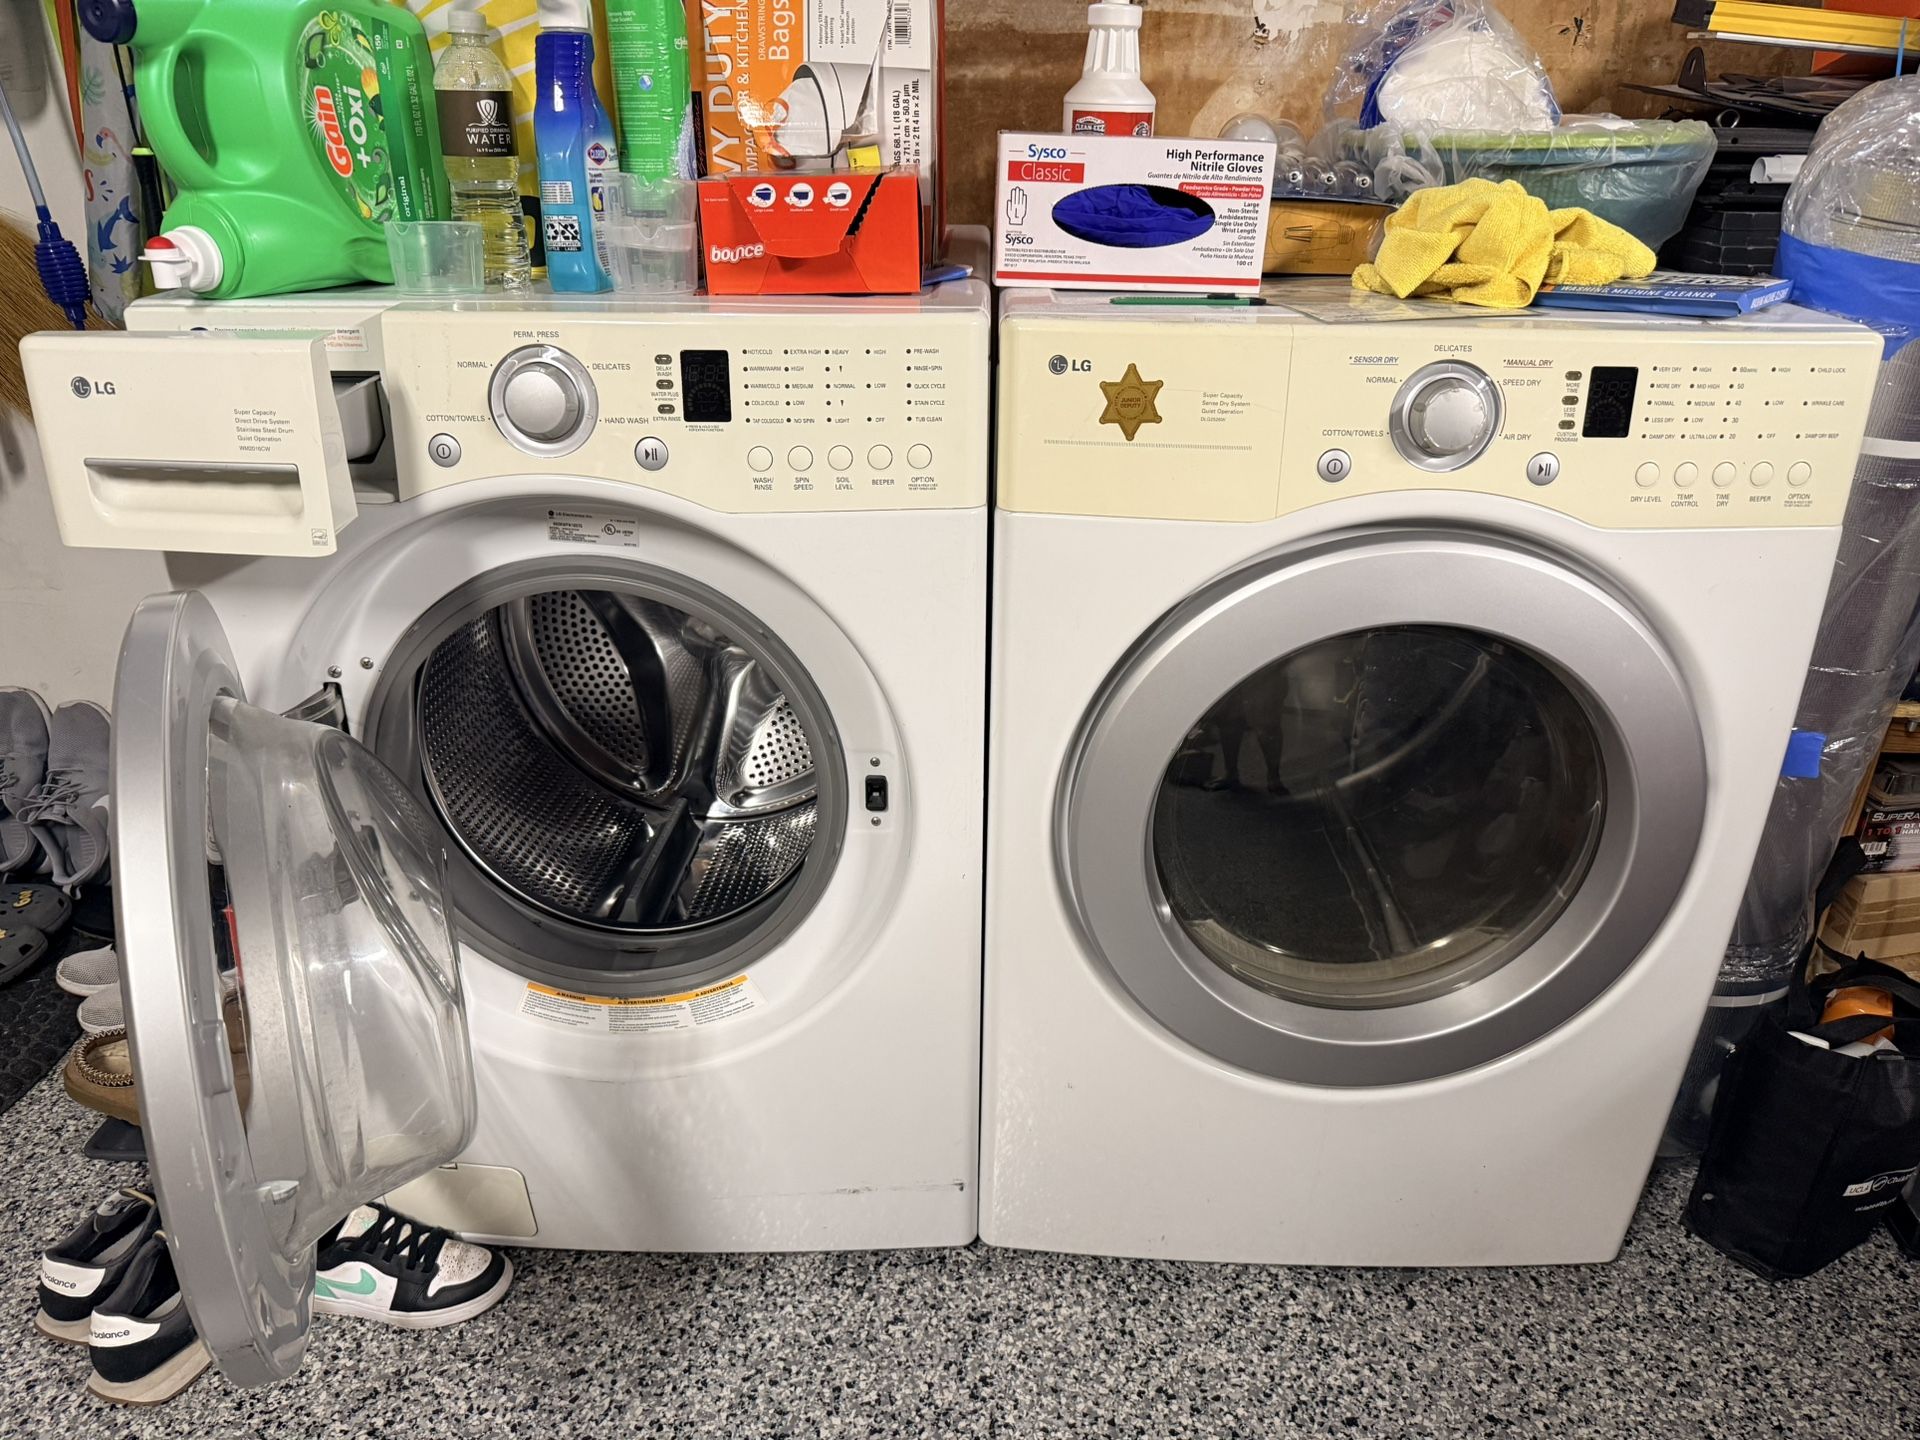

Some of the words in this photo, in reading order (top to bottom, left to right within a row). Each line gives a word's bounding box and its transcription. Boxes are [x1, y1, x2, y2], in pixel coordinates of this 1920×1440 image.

[736, 0, 749, 67] KITCHEN
[758, 0, 766, 60] DRAWSTRING
[768, 0, 795, 60] Bags
[737, 73, 749, 85] &
[892, 90, 902, 108] GAL)
[414, 110, 421, 118] OZ
[892, 110, 902, 123] (18
[313, 85, 353, 178] Gain
[904, 126, 910, 138] cm
[466, 134, 512, 144] WATER
[356, 147, 372, 168] +
[893, 150, 901, 166] AGS
[1028, 144, 1066, 160] Sysco
[1166, 149, 1192, 162] High
[1195, 150, 1264, 162] Performance
[1020, 162, 1072, 182] Classic
[1190, 161, 1224, 172] Nitrile
[1227, 162, 1264, 174] Gloves
[398, 176, 411, 217] original
[1005, 234, 1033, 246] Sysco
[710, 243, 765, 264] bounce
[1561, 285, 1609, 294] WASHING
[1612, 287, 1660, 297] MACHINE
[1664, 290, 1716, 298] CLEANER
[514, 330, 535, 338] PERM.
[536, 330, 560, 338] PRESS
[1072, 360, 1092, 372] LG
[95, 381, 116, 395] LG
[605, 416, 623, 424] HAND
[1872, 812, 1920, 822] SUPERA
[700, 982, 734, 996] ADVERTENCIA
[562, 992, 586, 1002] WARNING
[44, 1272, 77, 1290] balance
[94, 1329, 130, 1339] balance
